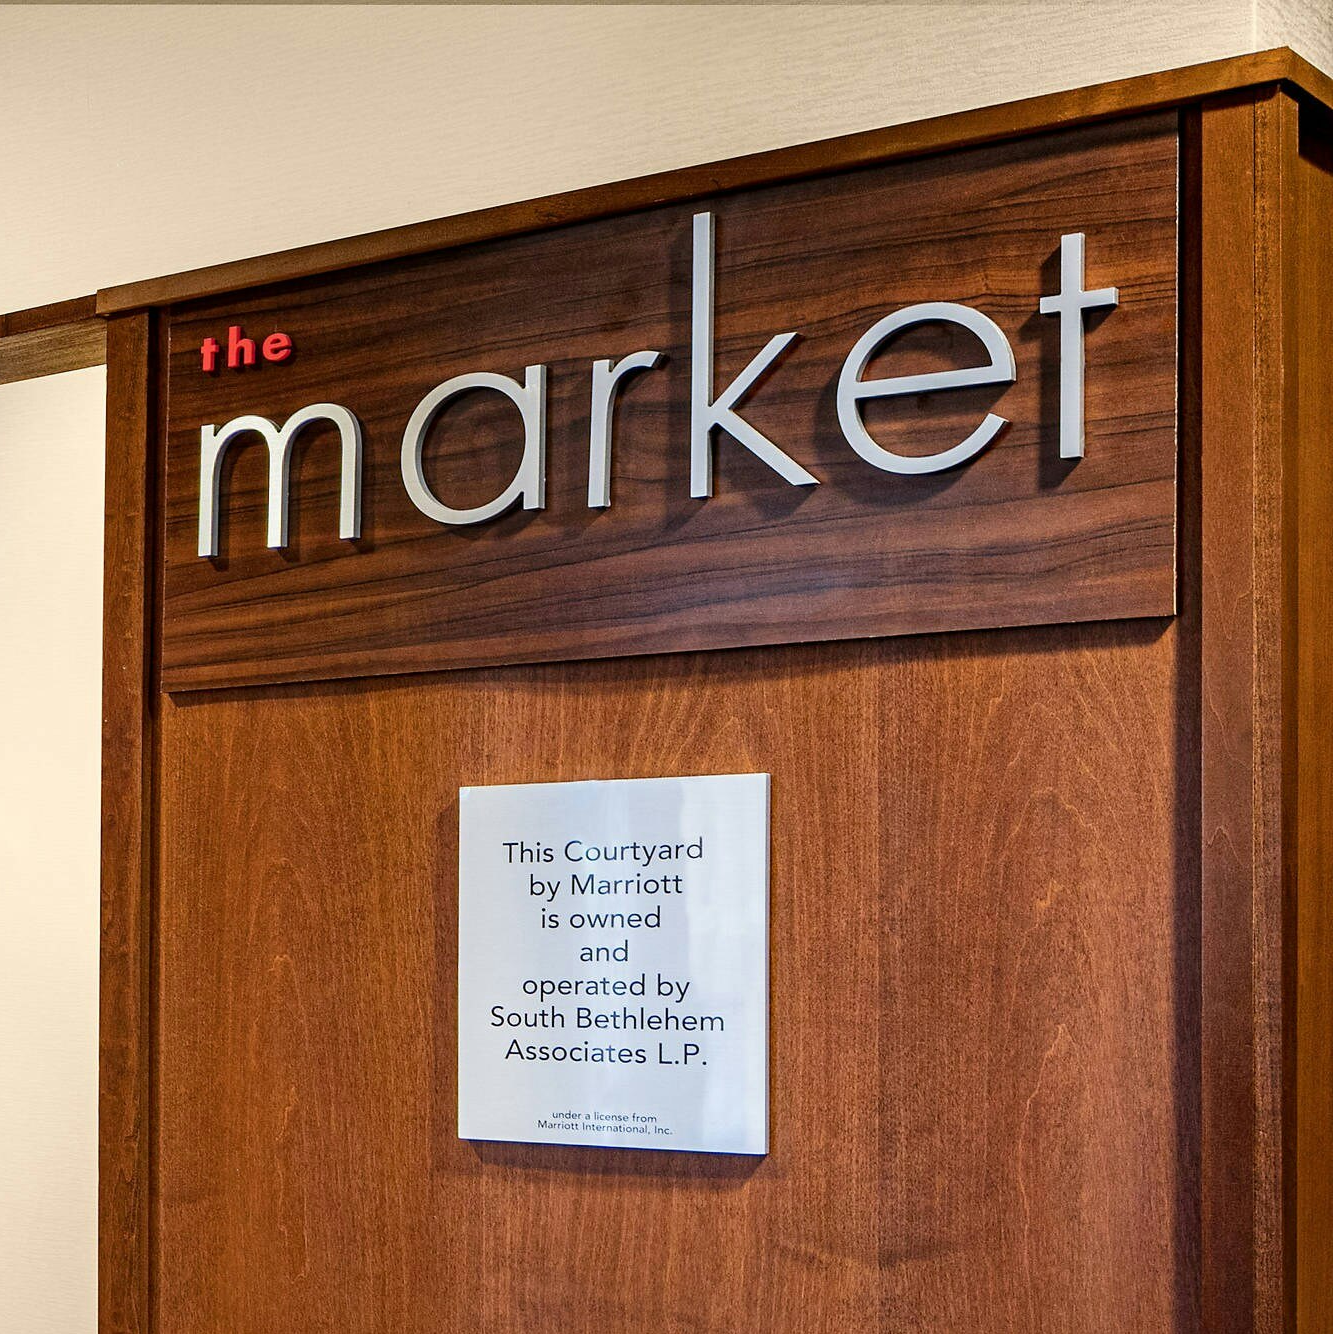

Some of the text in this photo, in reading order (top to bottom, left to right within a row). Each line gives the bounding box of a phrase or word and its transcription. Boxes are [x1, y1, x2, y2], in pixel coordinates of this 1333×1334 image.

[200, 325, 293, 372] the
[198, 211, 1120, 559] market
[502, 836, 704, 867] This Courtyard
[529, 873, 683, 902] by Marriott
[541, 906, 661, 929] is owned
[580, 940, 629, 962] and
[522, 974, 690, 1003] operated by
[490, 1006, 725, 1032] South Bethlehem
[505, 1039, 708, 1066] Associates L.P.
[538, 1120, 673, 1136] Marriott International, Inc.
[552, 1110, 581, 1120] under
[594, 1112, 629, 1122] license
[632, 1113, 657, 1123] from
